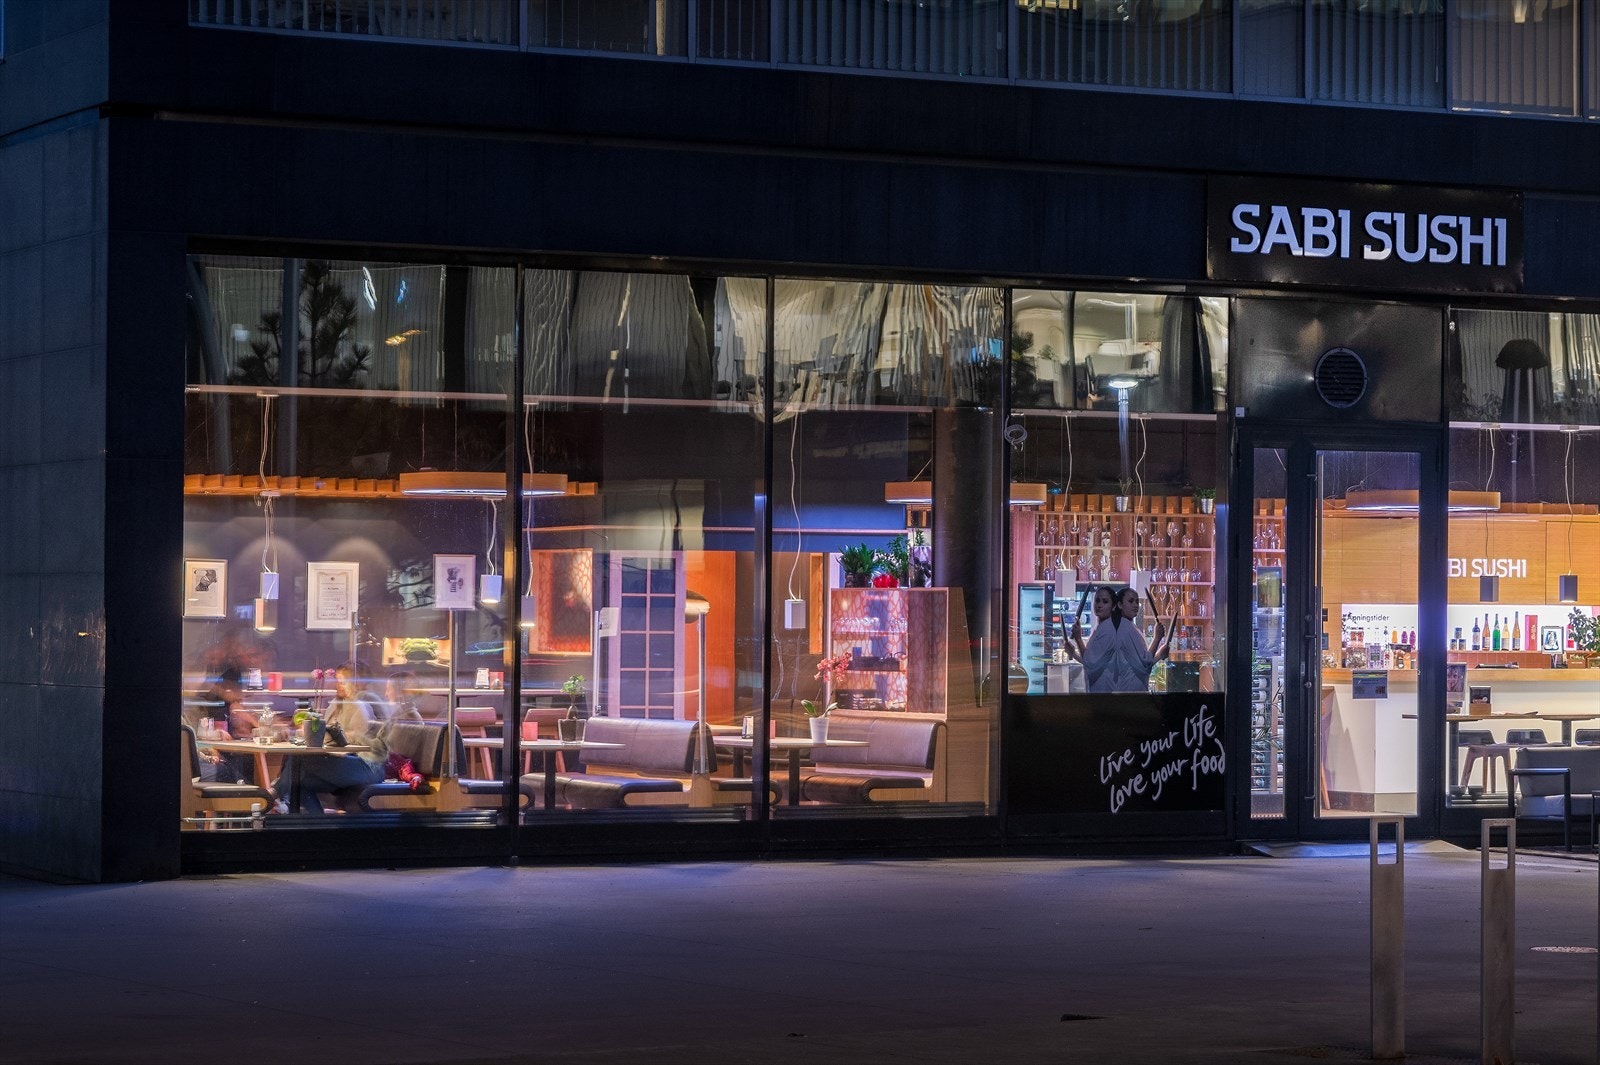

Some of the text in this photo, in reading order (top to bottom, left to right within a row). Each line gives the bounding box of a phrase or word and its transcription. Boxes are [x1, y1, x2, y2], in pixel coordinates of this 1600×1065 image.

[1230, 203, 1507, 266] SABI SUSHI
[1448, 558, 1527, 578] BI SUSHI
[1140, 731, 1180, 768] your
[1183, 704, 1217, 748] life
[1151, 759, 1189, 801] your
[1190, 737, 1226, 791] food
